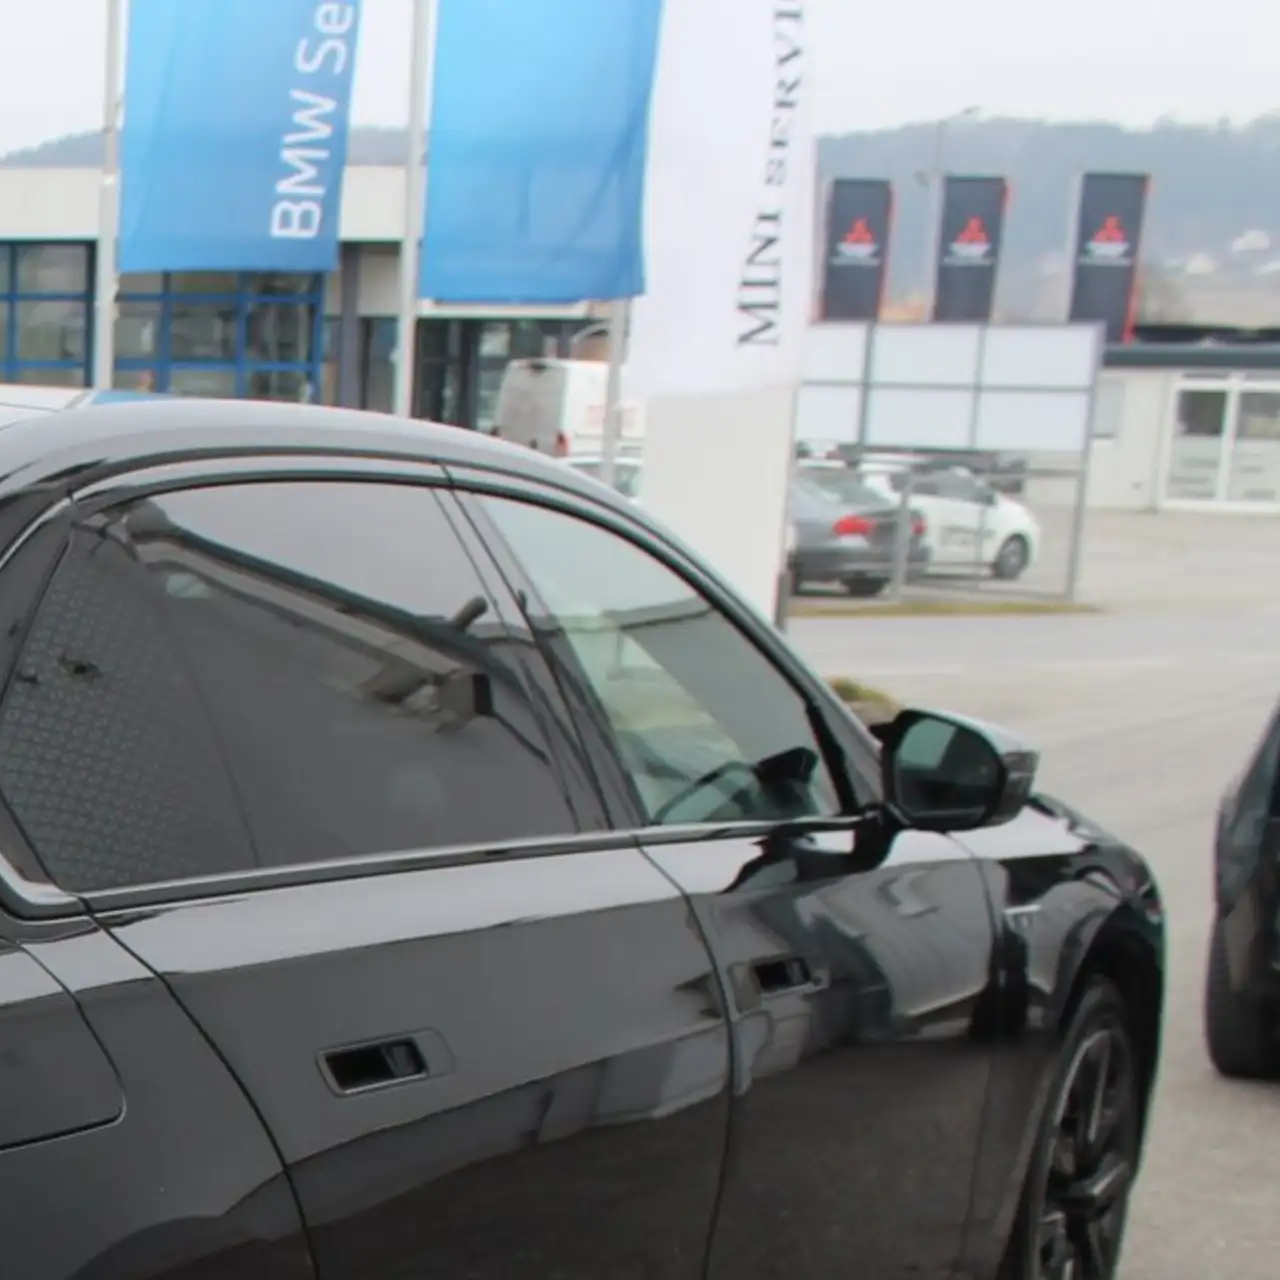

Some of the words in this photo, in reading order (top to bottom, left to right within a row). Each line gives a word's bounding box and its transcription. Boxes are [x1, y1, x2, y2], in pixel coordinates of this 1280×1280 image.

[269, 88, 338, 239] BMW
[736, 207, 781, 348] MINI
[764, 0, 803, 186] SERVI
